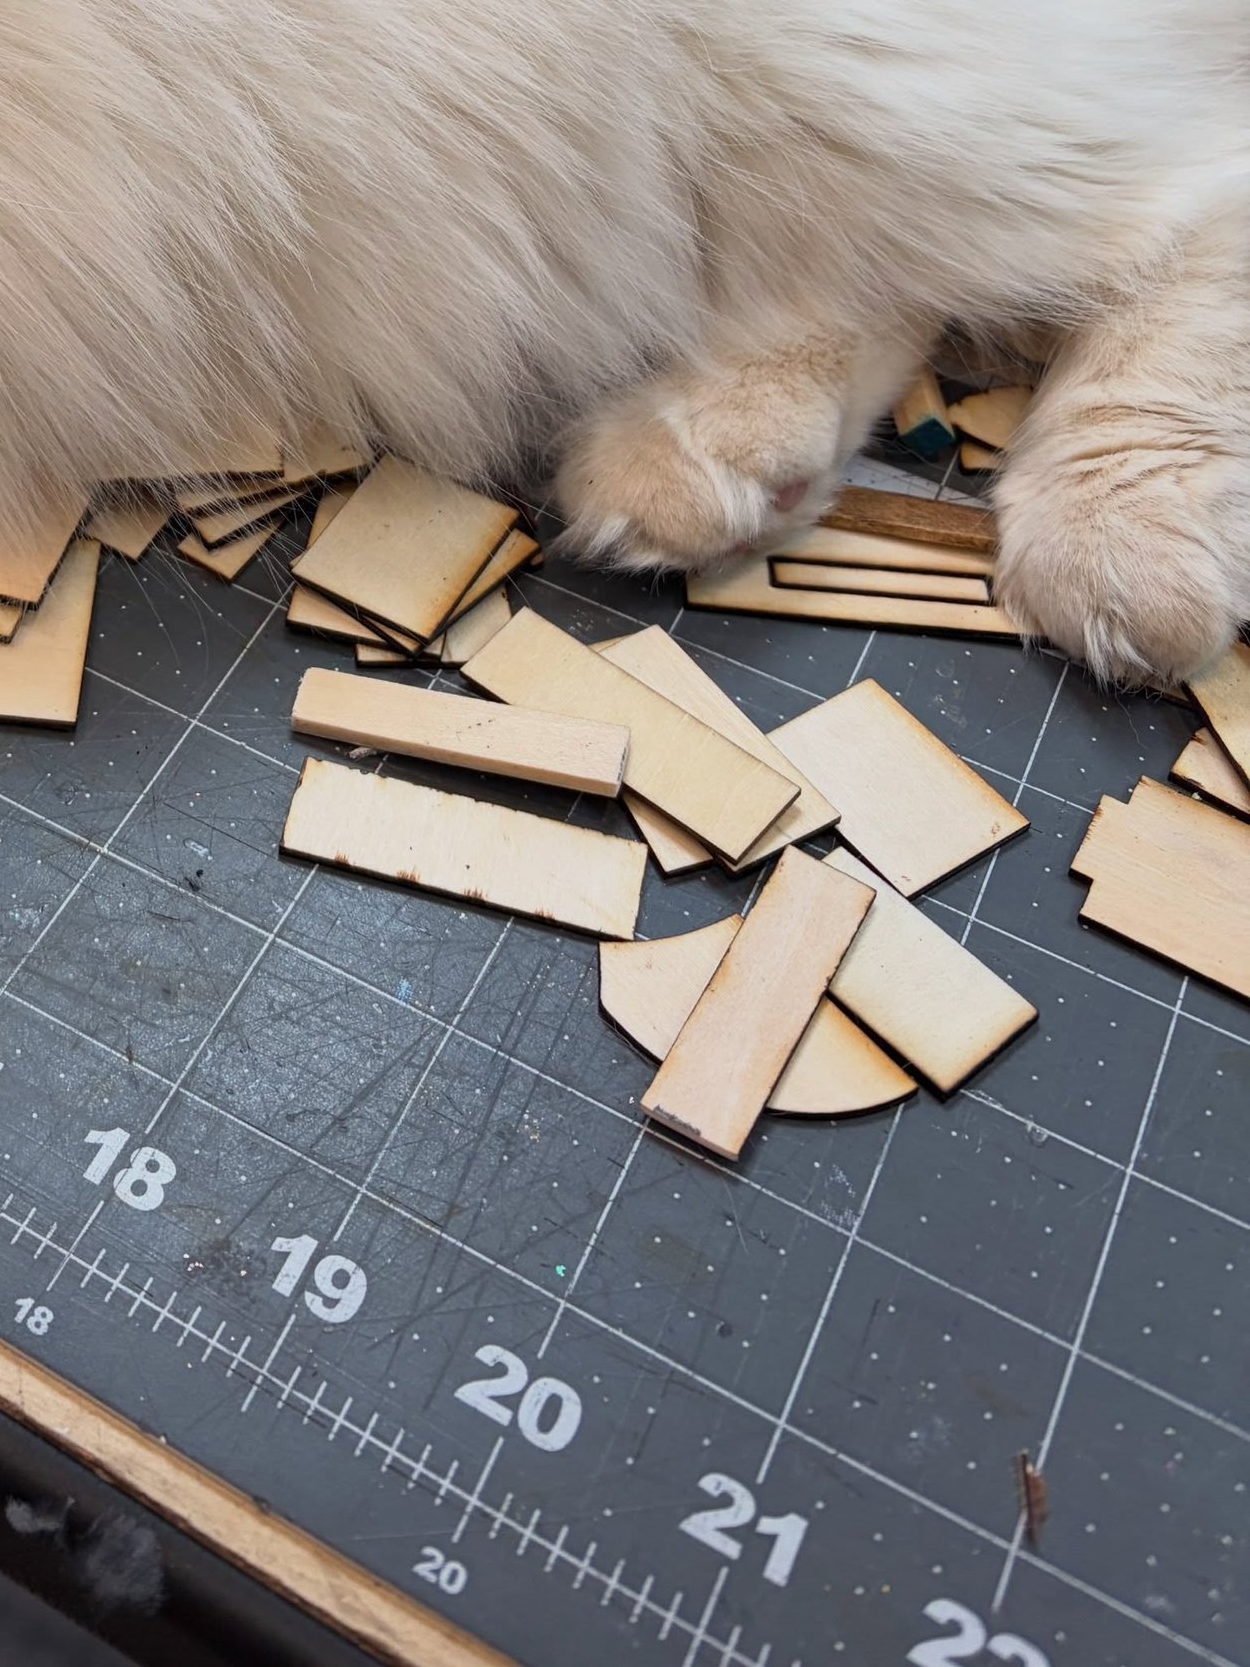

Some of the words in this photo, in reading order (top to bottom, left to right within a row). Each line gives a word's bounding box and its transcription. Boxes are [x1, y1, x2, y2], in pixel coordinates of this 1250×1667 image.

[83, 1126, 177, 1212] 18
[13, 1296, 55, 1337] 18
[269, 1233, 368, 1324] 19
[454, 1344, 583, 1452] 20
[412, 1546, 468, 1596] 20
[680, 1472, 810, 1588] 21
